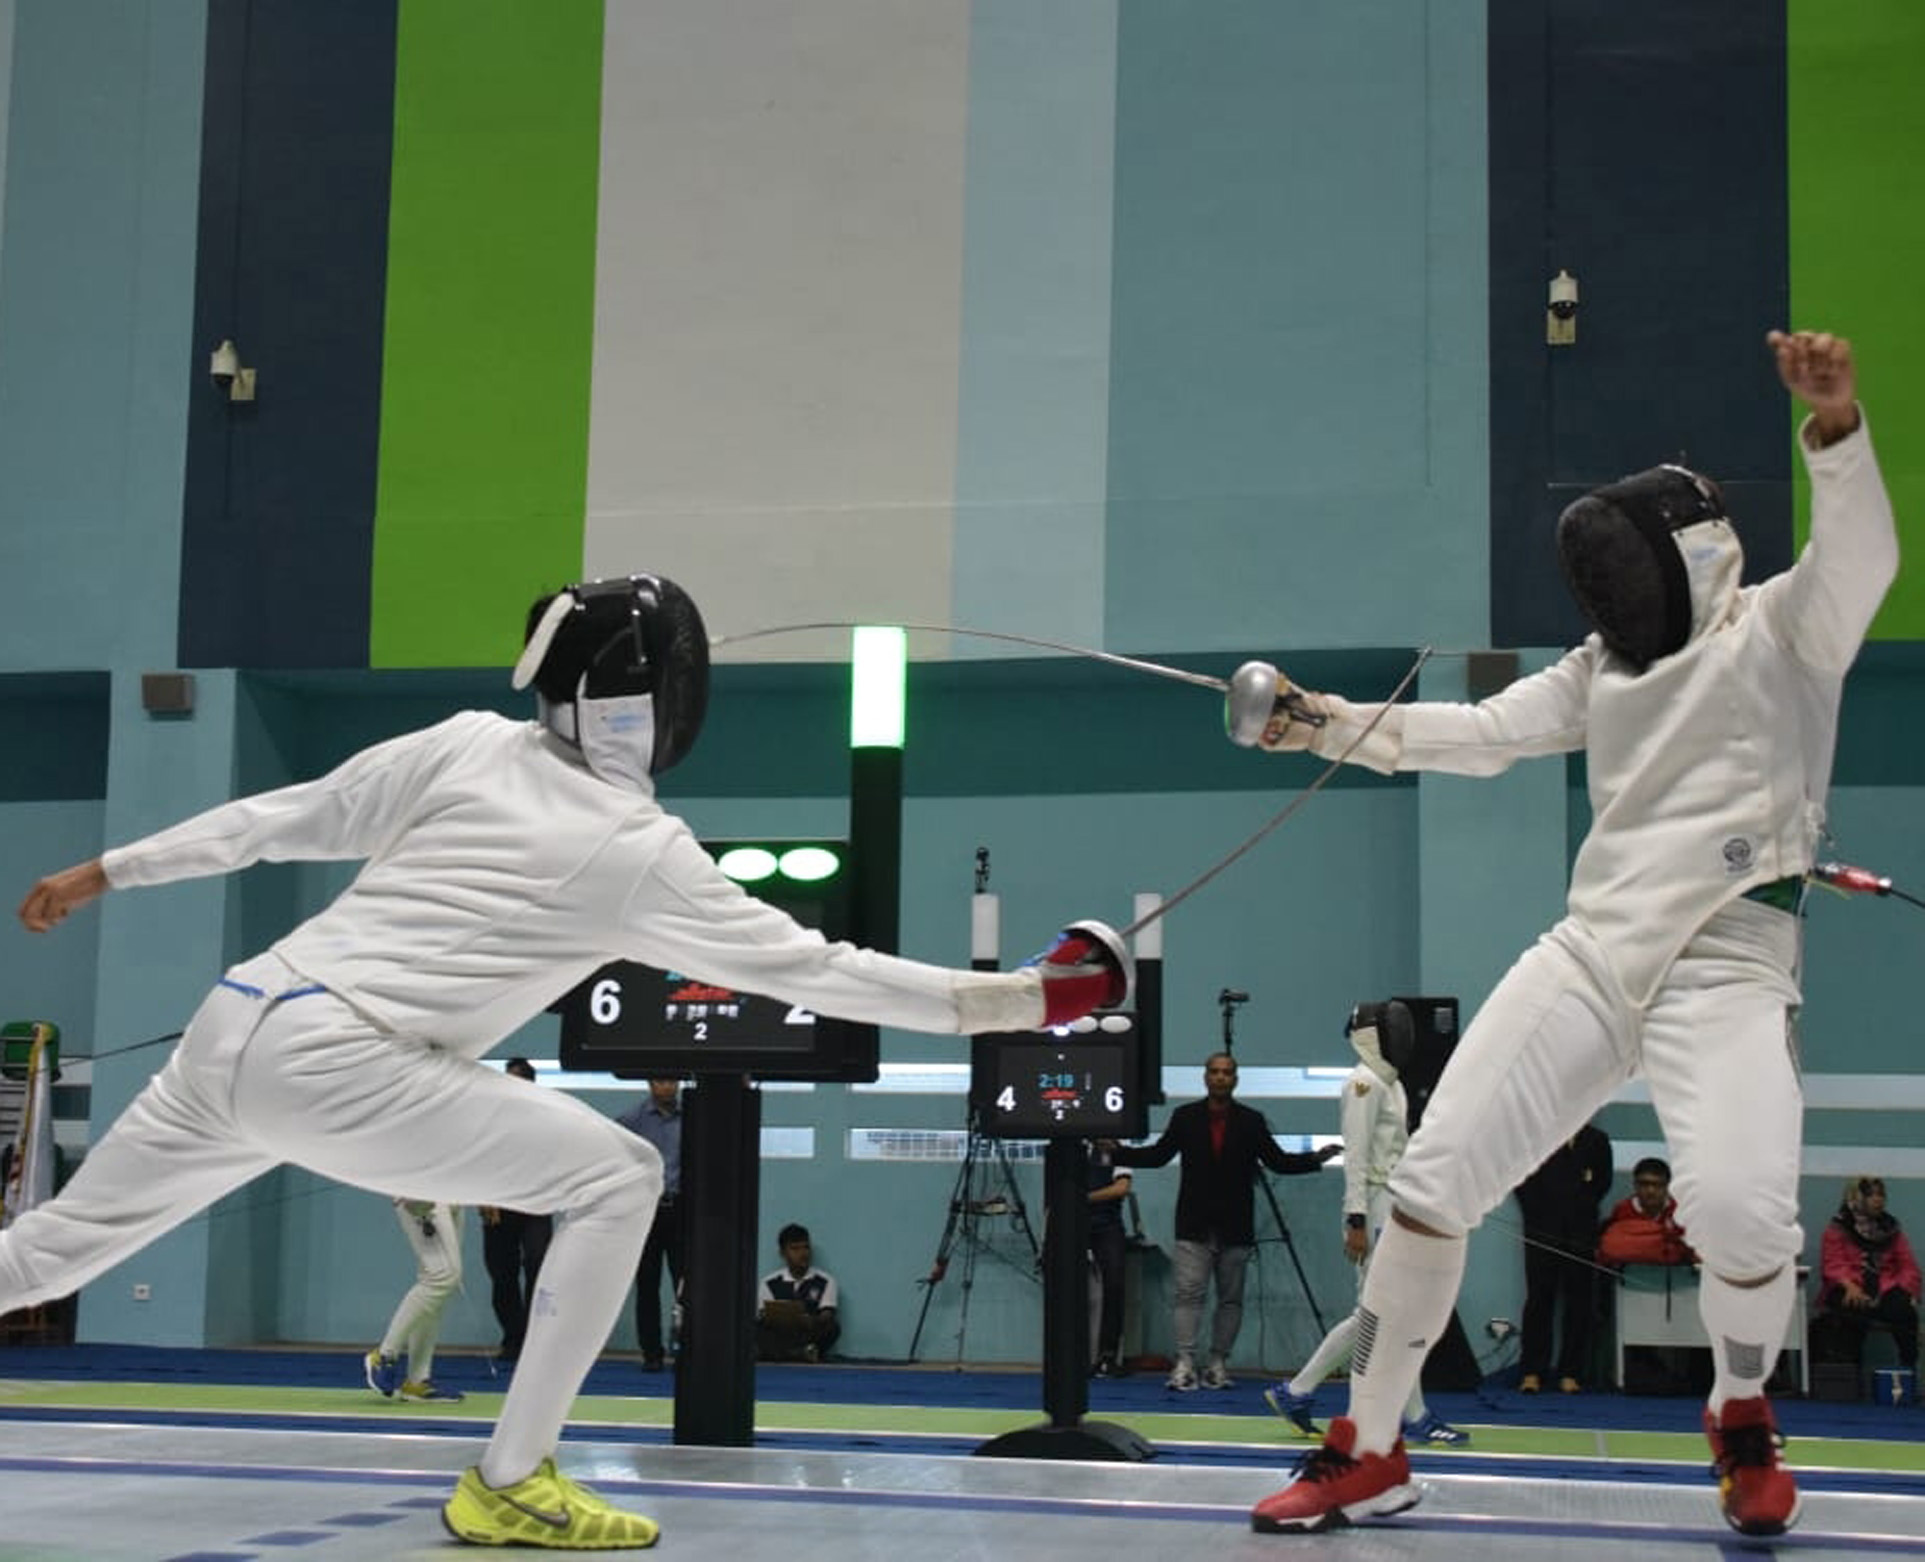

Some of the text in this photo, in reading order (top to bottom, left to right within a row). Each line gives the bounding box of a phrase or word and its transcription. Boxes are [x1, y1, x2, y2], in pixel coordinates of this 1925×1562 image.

[590, 979, 621, 1024] 6
[693, 1022, 708, 1040] 2
[996, 1086, 1017, 1111] 4
[1105, 1086, 1124, 1112] 6
